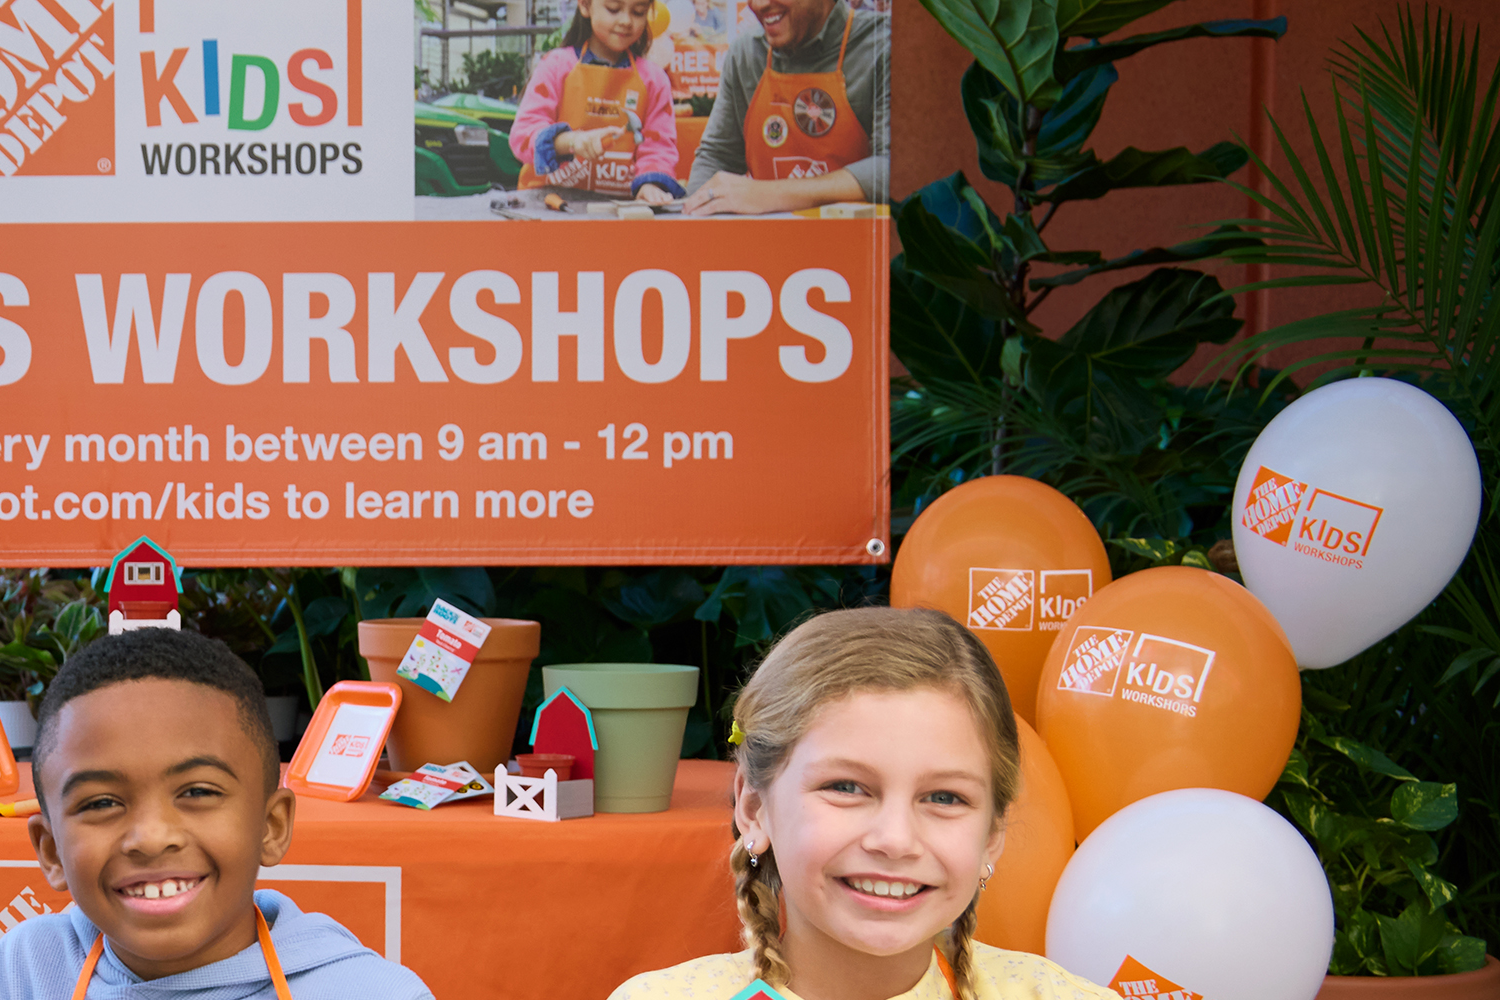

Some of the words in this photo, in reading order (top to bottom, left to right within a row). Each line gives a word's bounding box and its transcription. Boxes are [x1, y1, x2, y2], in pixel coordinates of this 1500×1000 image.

[670, 51, 710, 73] REE
[140, 39, 339, 131] KIDS
[141, 142, 363, 176] WORKSHOPS
[75, 268, 854, 385] WORKSHOPS
[64, 427, 210, 464] month
[226, 425, 423, 462] between
[437, 424, 465, 461] 9
[478, 431, 548, 461] am
[598, 423, 649, 460] 12
[663, 428, 734, 468] pm
[283, 484, 330, 519] to
[345, 481, 460, 519] learn
[474, 487, 594, 519] more
[1244, 481, 1304, 529] HOME
[1253, 477, 1278, 499] THE
[1256, 506, 1297, 537] DEPOT
[1299, 516, 1362, 554] KIDS
[1294, 541, 1364, 570] WORKSHOPS
[970, 571, 1034, 628] HOME
[977, 576, 1005, 600] THE
[994, 592, 1032, 629] DEPOT
[436, 628, 462, 650] Tomato
[1073, 634, 1099, 658] THE
[1061, 630, 1129, 688] HOME
[1078, 652, 1121, 690] DEPOT
[1126, 662, 1195, 698] KIDS
[1122, 688, 1197, 718] WORKSHOPS
[1118, 979, 1160, 997] THE
